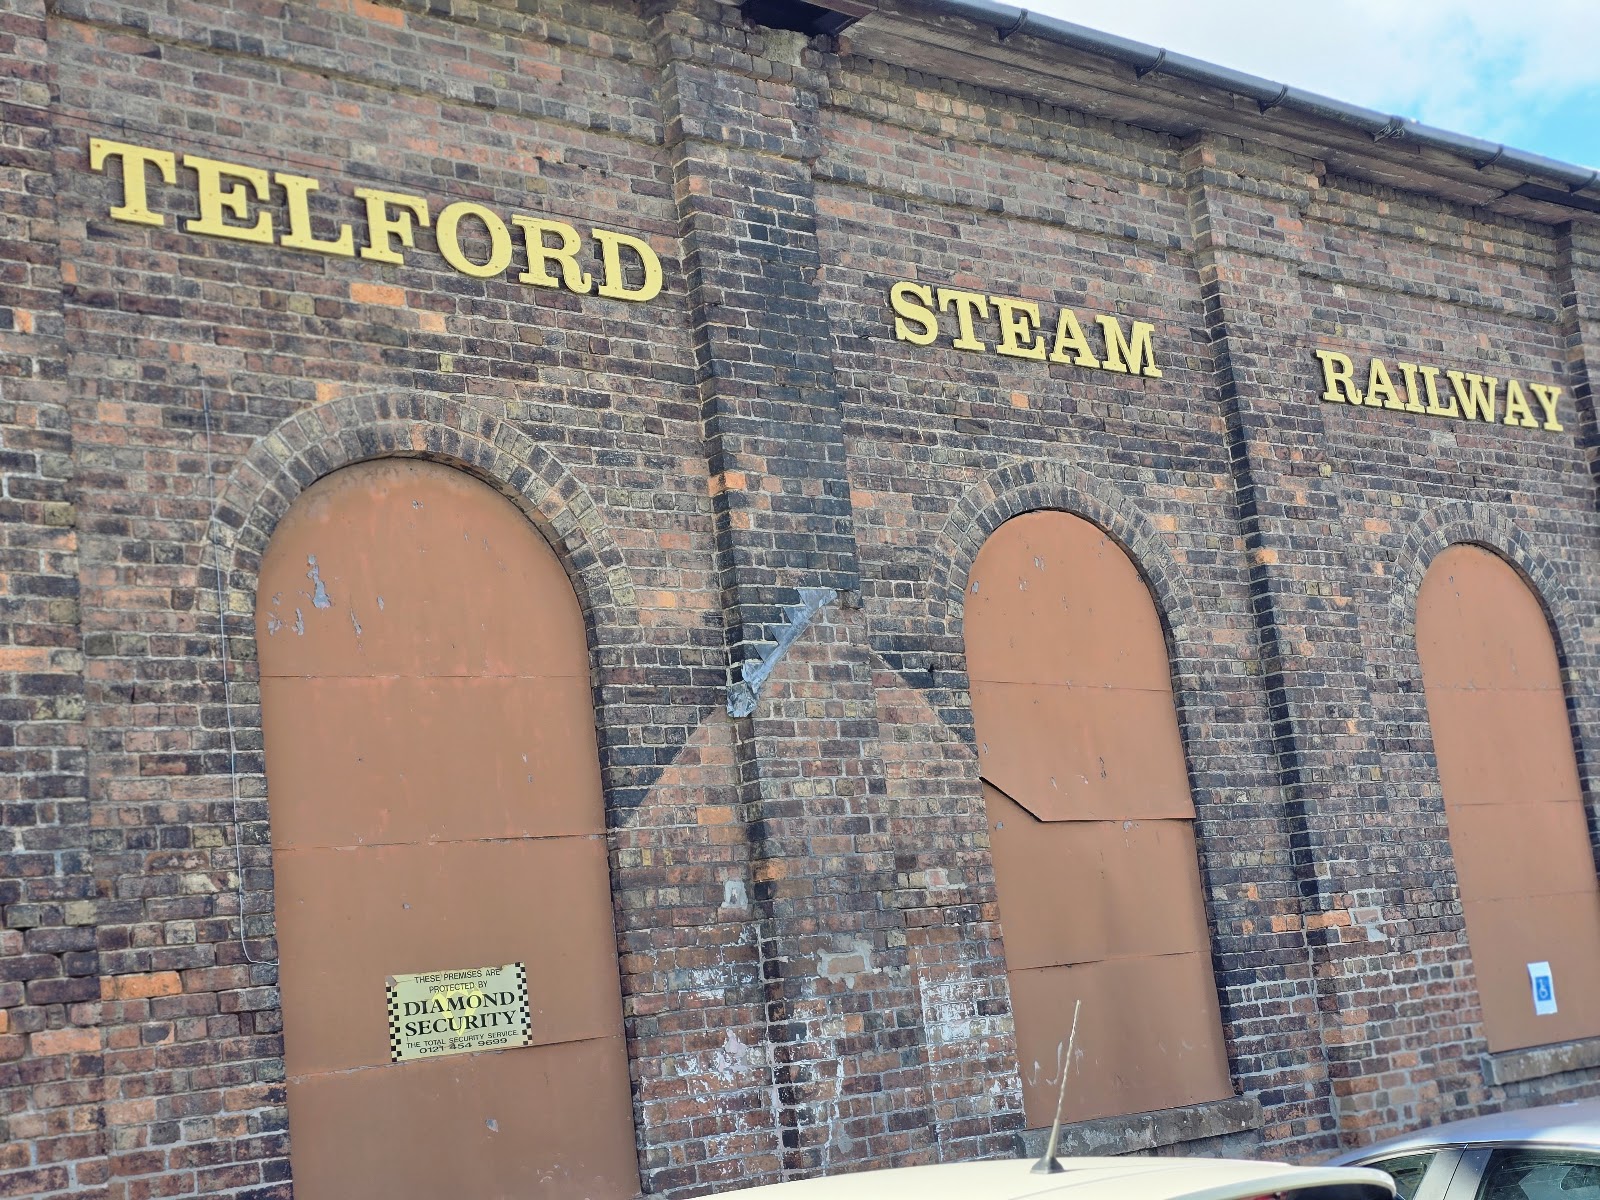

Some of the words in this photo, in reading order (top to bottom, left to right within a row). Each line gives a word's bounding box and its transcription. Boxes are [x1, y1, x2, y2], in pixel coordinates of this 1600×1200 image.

[89, 137, 664, 302] TELFORD
[890, 281, 1163, 378] STEAM
[1315, 349, 1564, 432] RAILWAY
[414, 972, 441, 984] THESE
[443, 969, 483, 981] PREMISES
[485, 968, 501, 977] ARE
[429, 981, 475, 994] PROTECTED
[478, 980, 488, 989] BY
[403, 991, 515, 1016] DIAMOND
[404, 1010, 517, 1037] SECURITY
[406, 1041, 421, 1049] THE
[424, 1038, 446, 1047] TOTAL
[448, 1034, 485, 1044] SECURITY
[419, 1045, 444, 1054] 0121
[449, 1042, 473, 1050] 454
[477, 1038, 508, 1047] 9699
